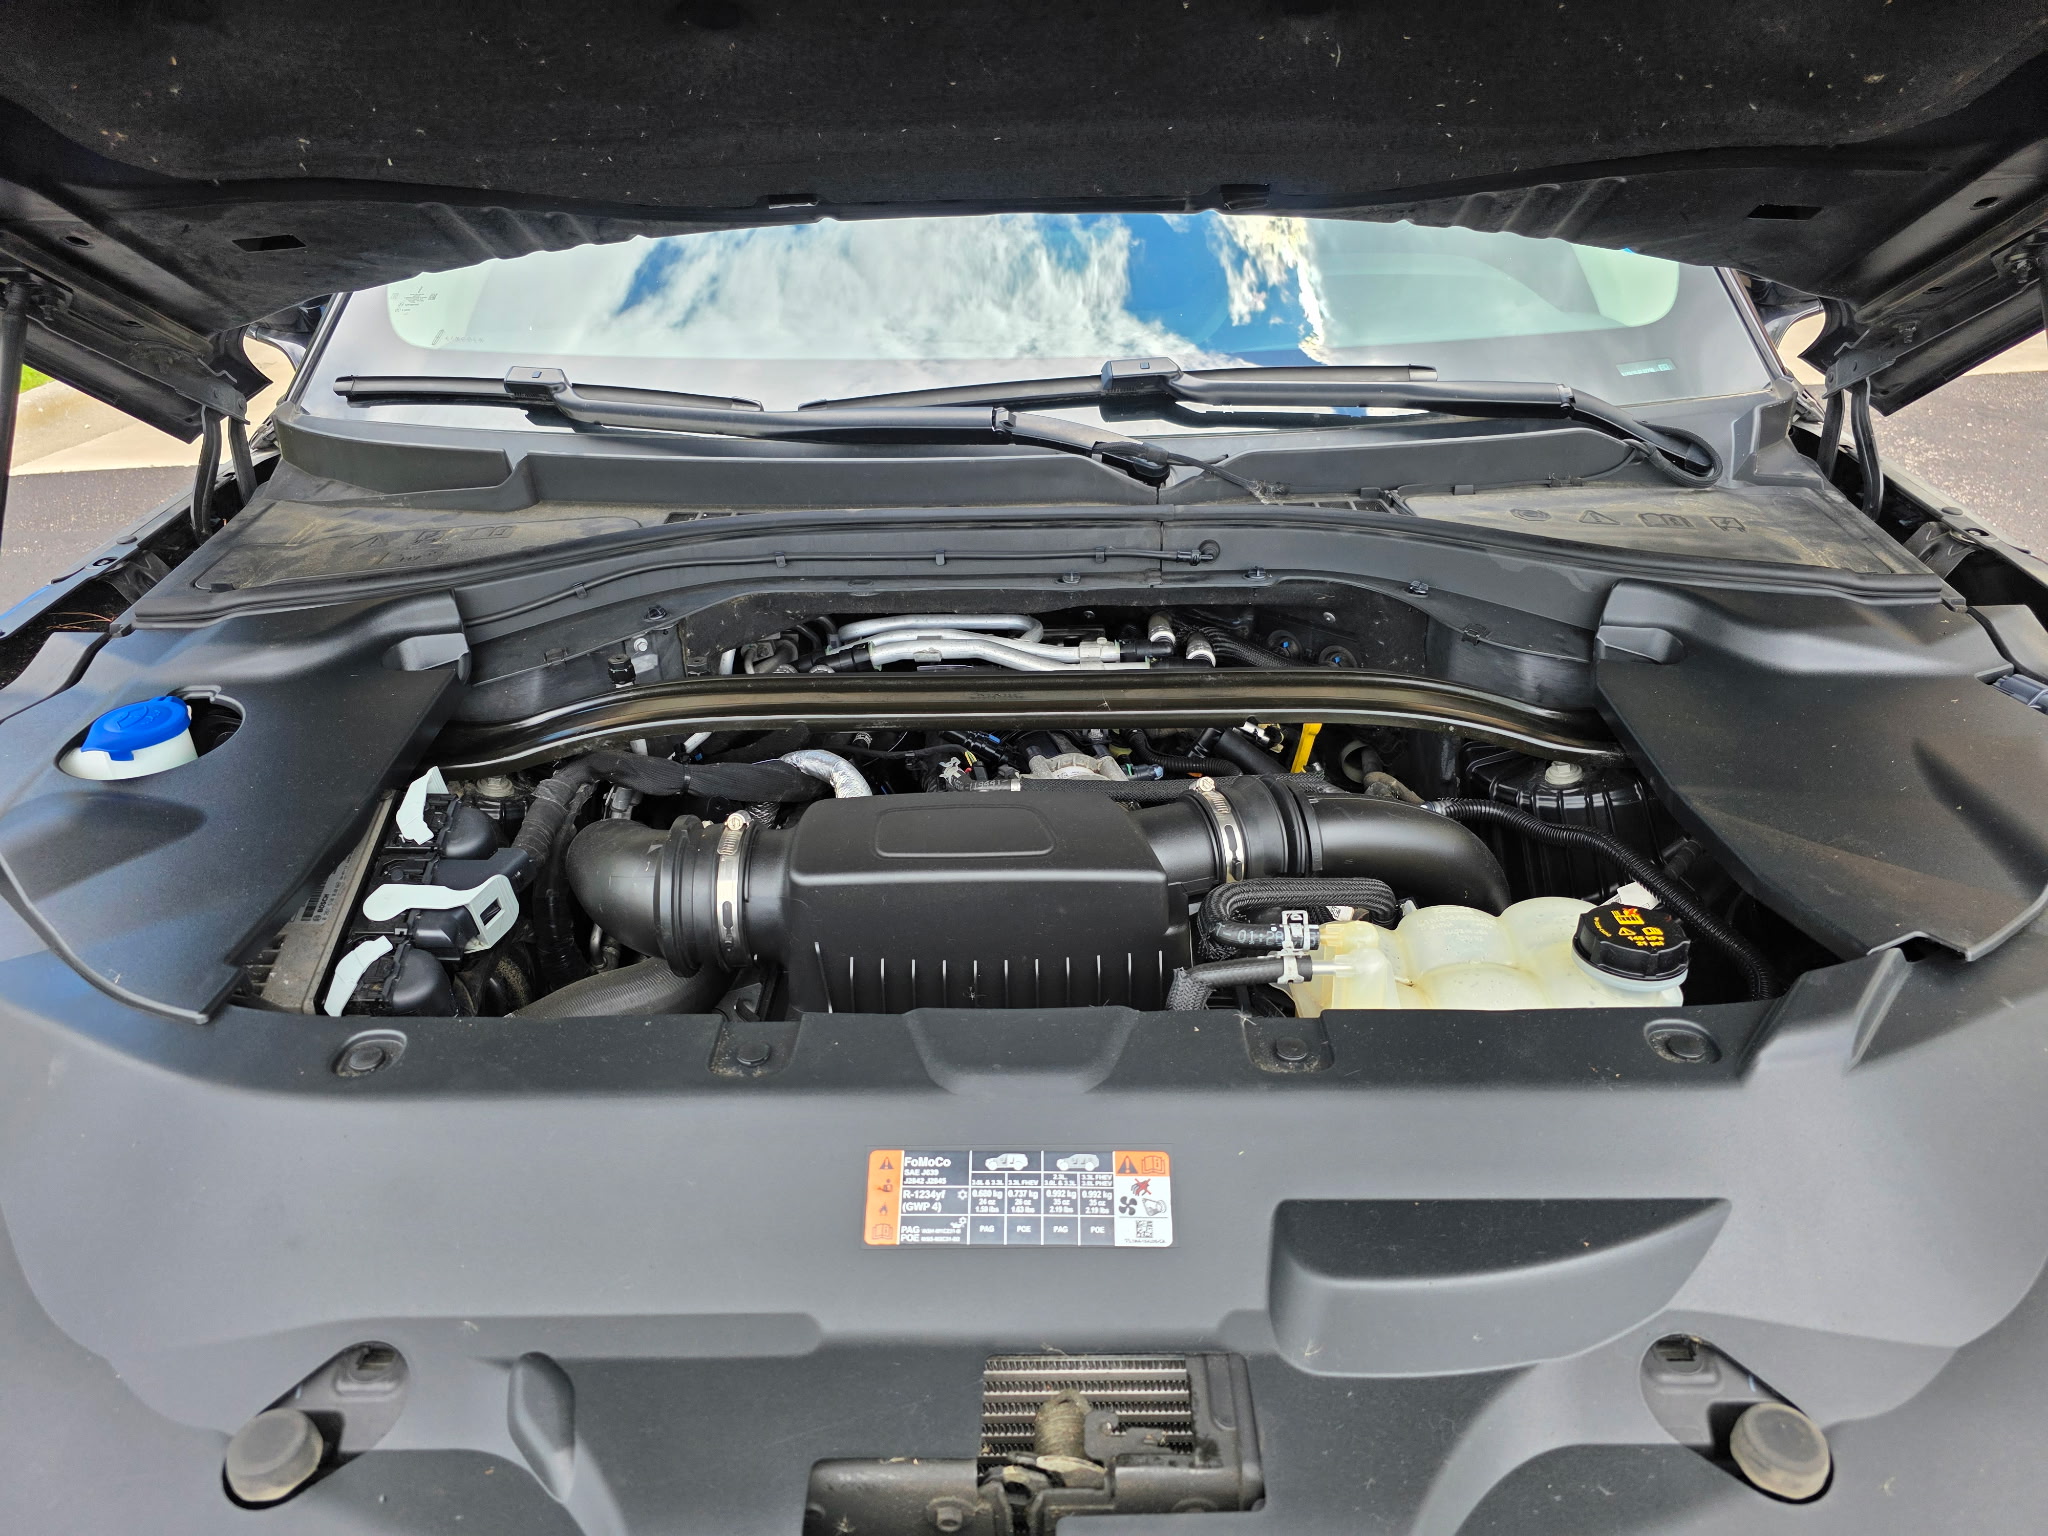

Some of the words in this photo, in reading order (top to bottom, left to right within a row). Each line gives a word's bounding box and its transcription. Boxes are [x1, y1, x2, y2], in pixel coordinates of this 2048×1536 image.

[317, 894, 330, 913] BOSCH
[904, 1157, 951, 1167] FoMoCo
[903, 1190, 946, 1200] R-1234yf
[992, 1189, 1003, 1200] kg
[1007, 1189, 1028, 1198] 0.737
[1028, 1189, 1039, 1200] kg
[1066, 1189, 1077, 1200] kg
[1102, 1190, 1113, 1200] kg
[902, 1202, 931, 1213] (GWP
[931, 1202, 942, 1213] 4)
[989, 1205, 1000, 1213] lbs
[1025, 1205, 1035, 1213] lbs
[1063, 1205, 1074, 1213] lbs
[1099, 1206, 1110, 1214] lbs
[979, 1225, 995, 1233] PAG
[1016, 1225, 1031, 1233] POE
[1053, 1225, 1068, 1233] PAG
[1090, 1226, 1105, 1234] POE
